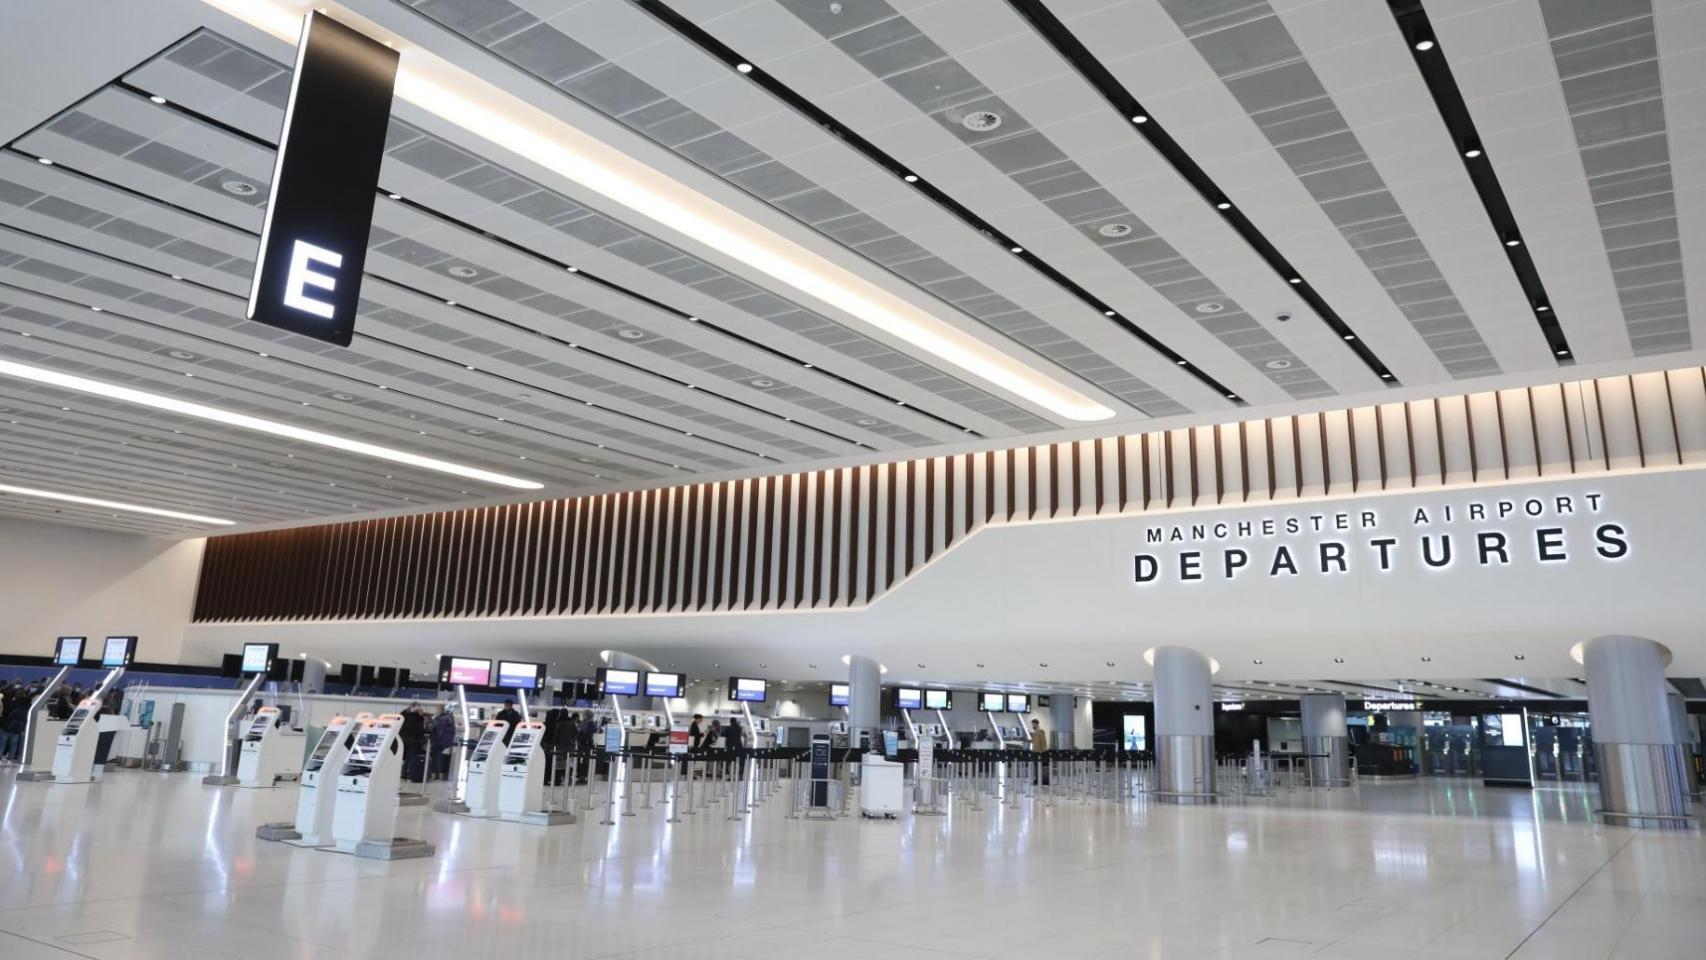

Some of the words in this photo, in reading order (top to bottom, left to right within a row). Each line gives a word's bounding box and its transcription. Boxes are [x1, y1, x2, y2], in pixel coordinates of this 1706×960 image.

[283, 239, 343, 319] E
[1147, 511, 1378, 542] MANCHESTER
[1414, 493, 1603, 524] AIRPORT
[1134, 524, 1630, 582] DEPARTURES
[1364, 701, 1415, 712] Departures
